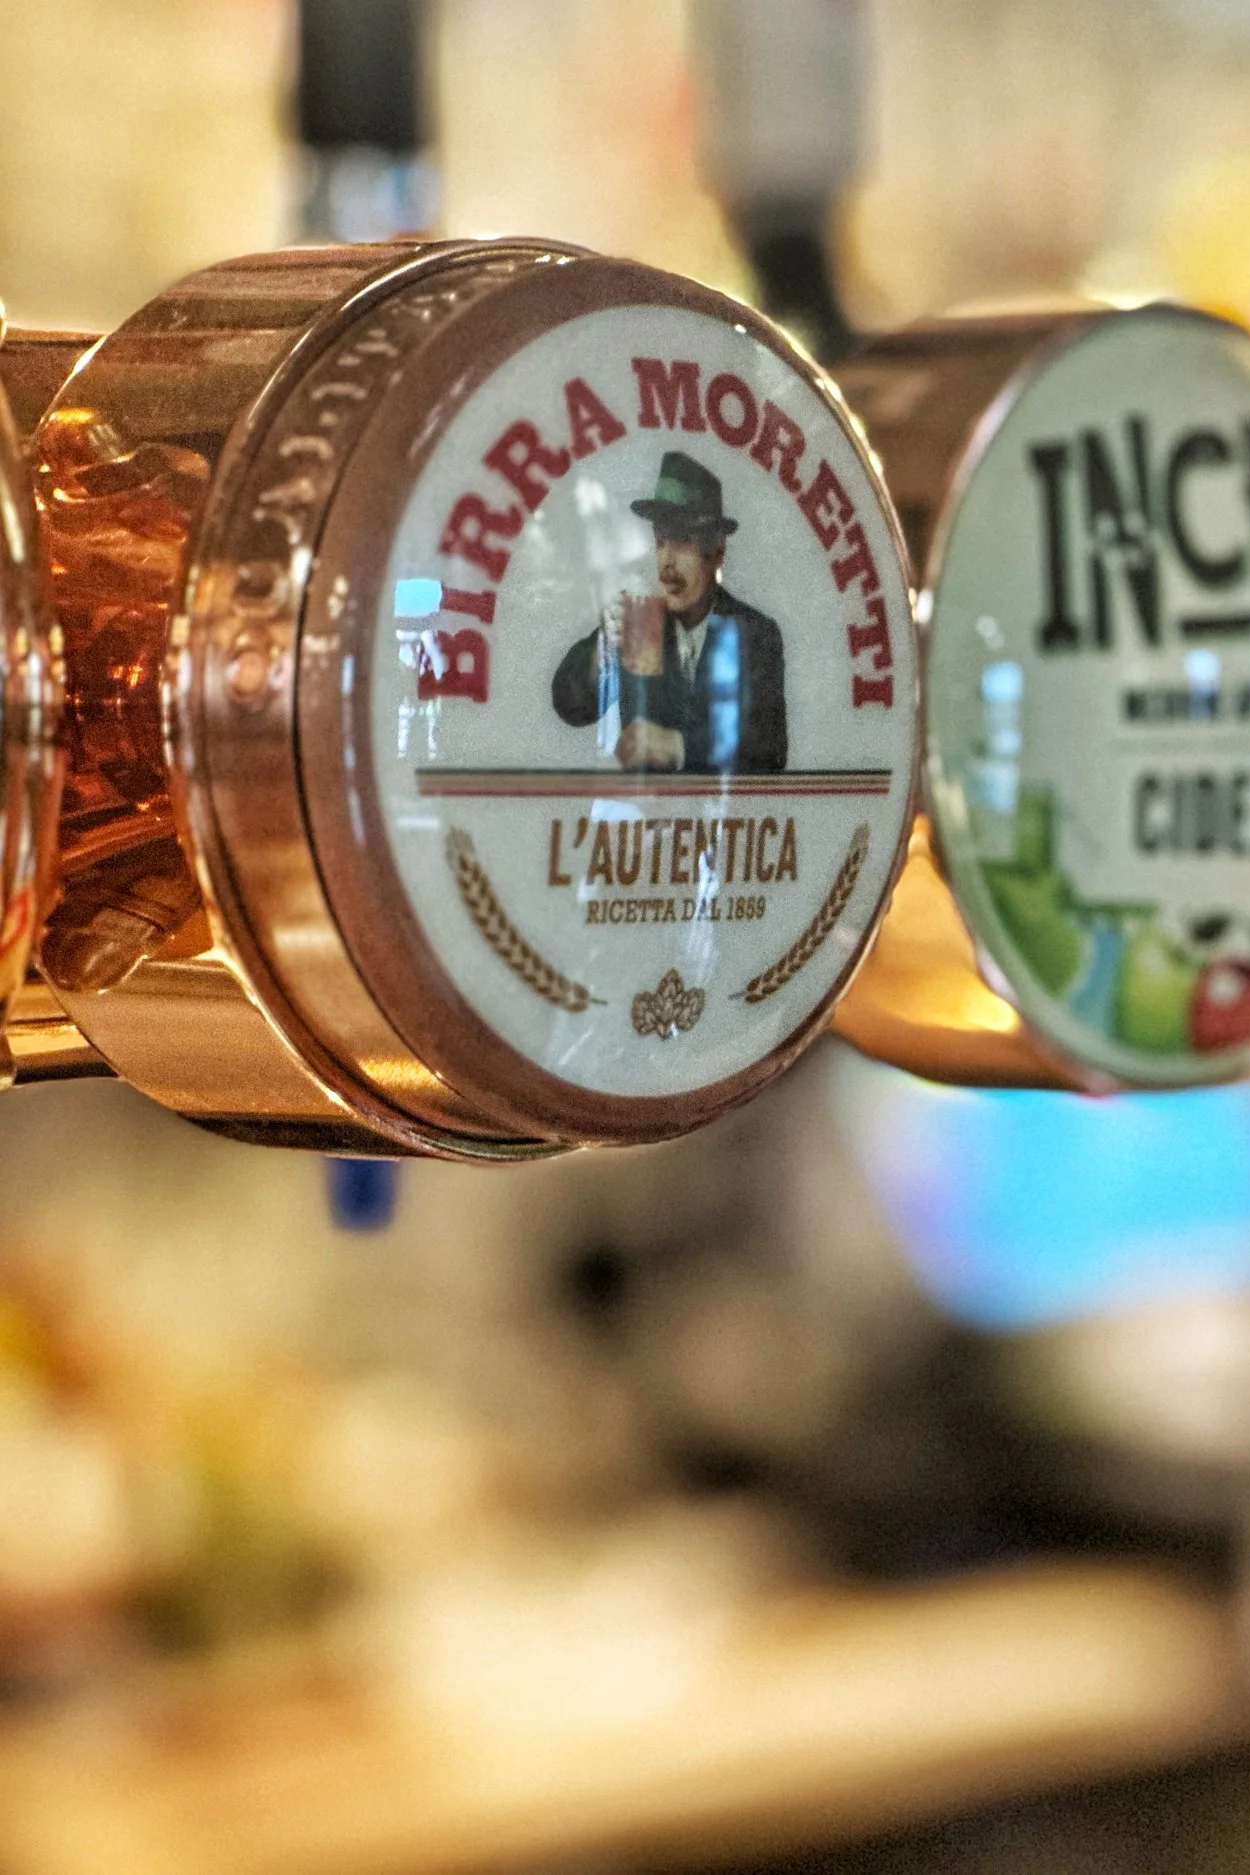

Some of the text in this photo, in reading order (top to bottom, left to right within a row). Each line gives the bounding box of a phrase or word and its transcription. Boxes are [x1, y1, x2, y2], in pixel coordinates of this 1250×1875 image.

[417, 356, 894, 709] BIRRA MORETTI
[547, 816, 798, 887] L'AUTENTICA
[585, 899, 677, 924] RICETTA
[727, 896, 767, 921] 1859
